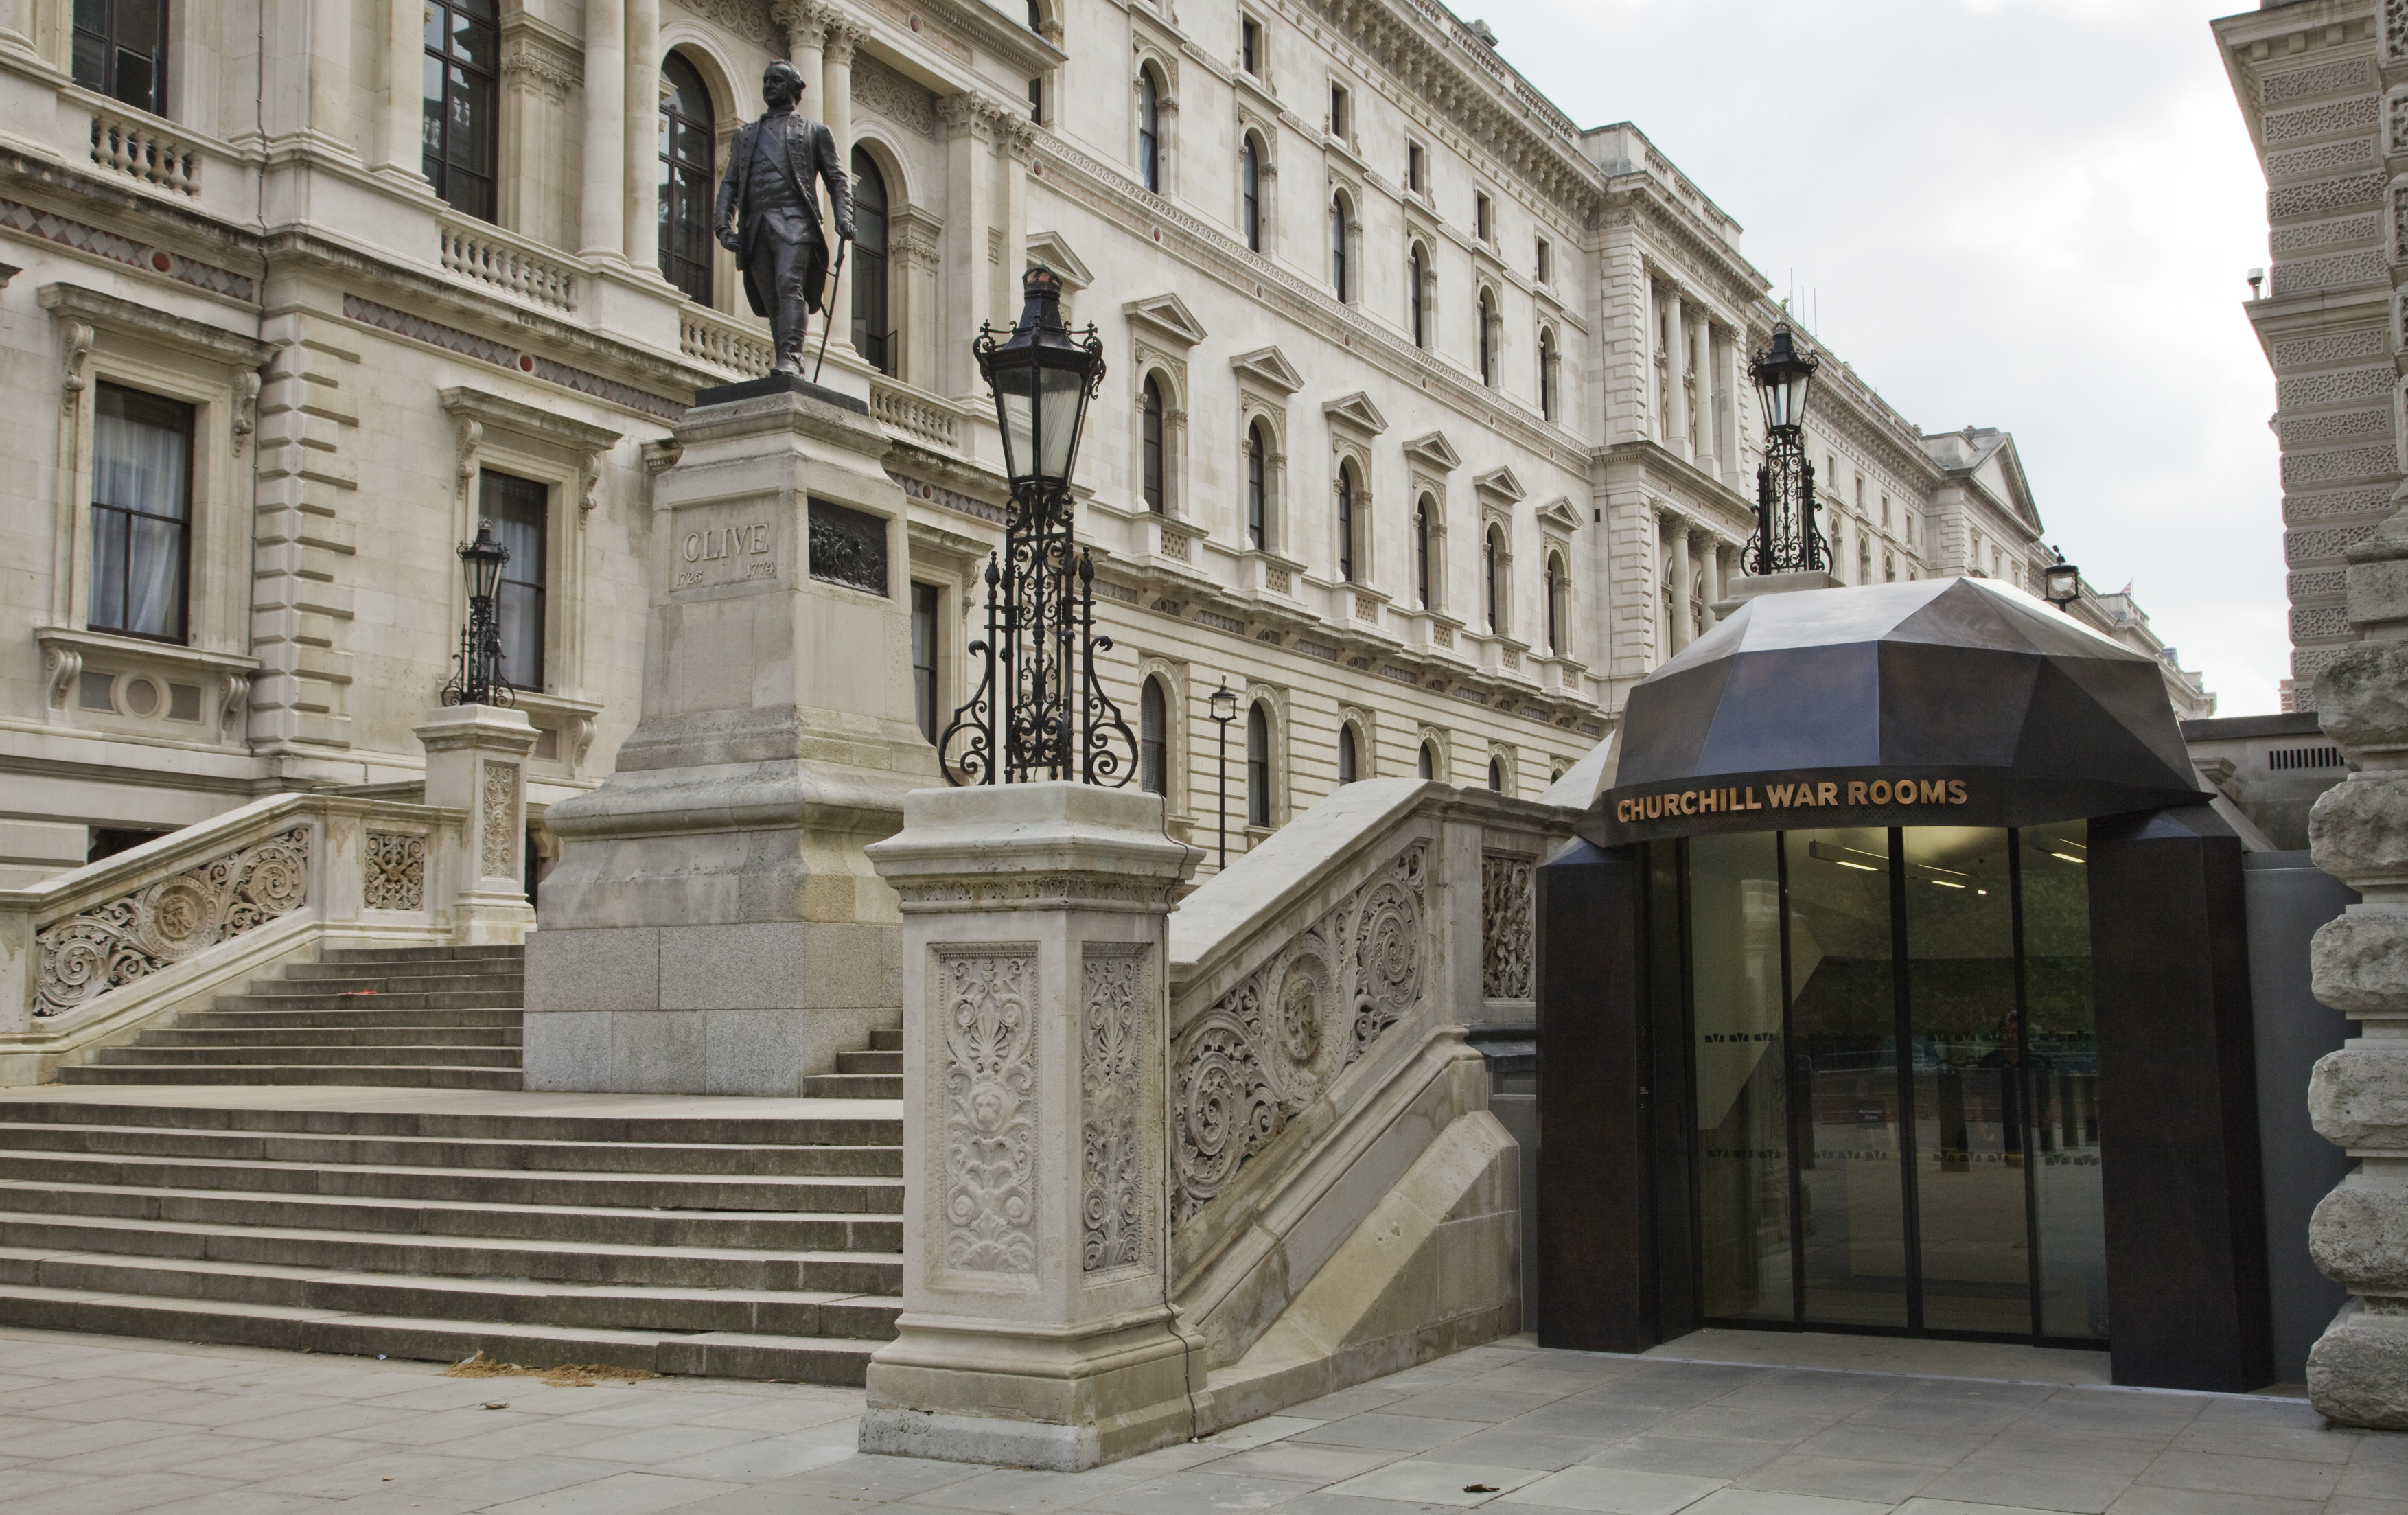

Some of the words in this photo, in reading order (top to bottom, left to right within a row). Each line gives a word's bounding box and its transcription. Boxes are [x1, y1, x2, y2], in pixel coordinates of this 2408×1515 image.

[683, 523, 769, 562] CLIVE
[676, 570, 703, 586] 1725
[747, 562, 774, 577] 1774
[1617, 785, 1761, 822] CHURCHILL
[1766, 782, 1839, 808] WAR
[1848, 780, 1967, 805] ROOMS
